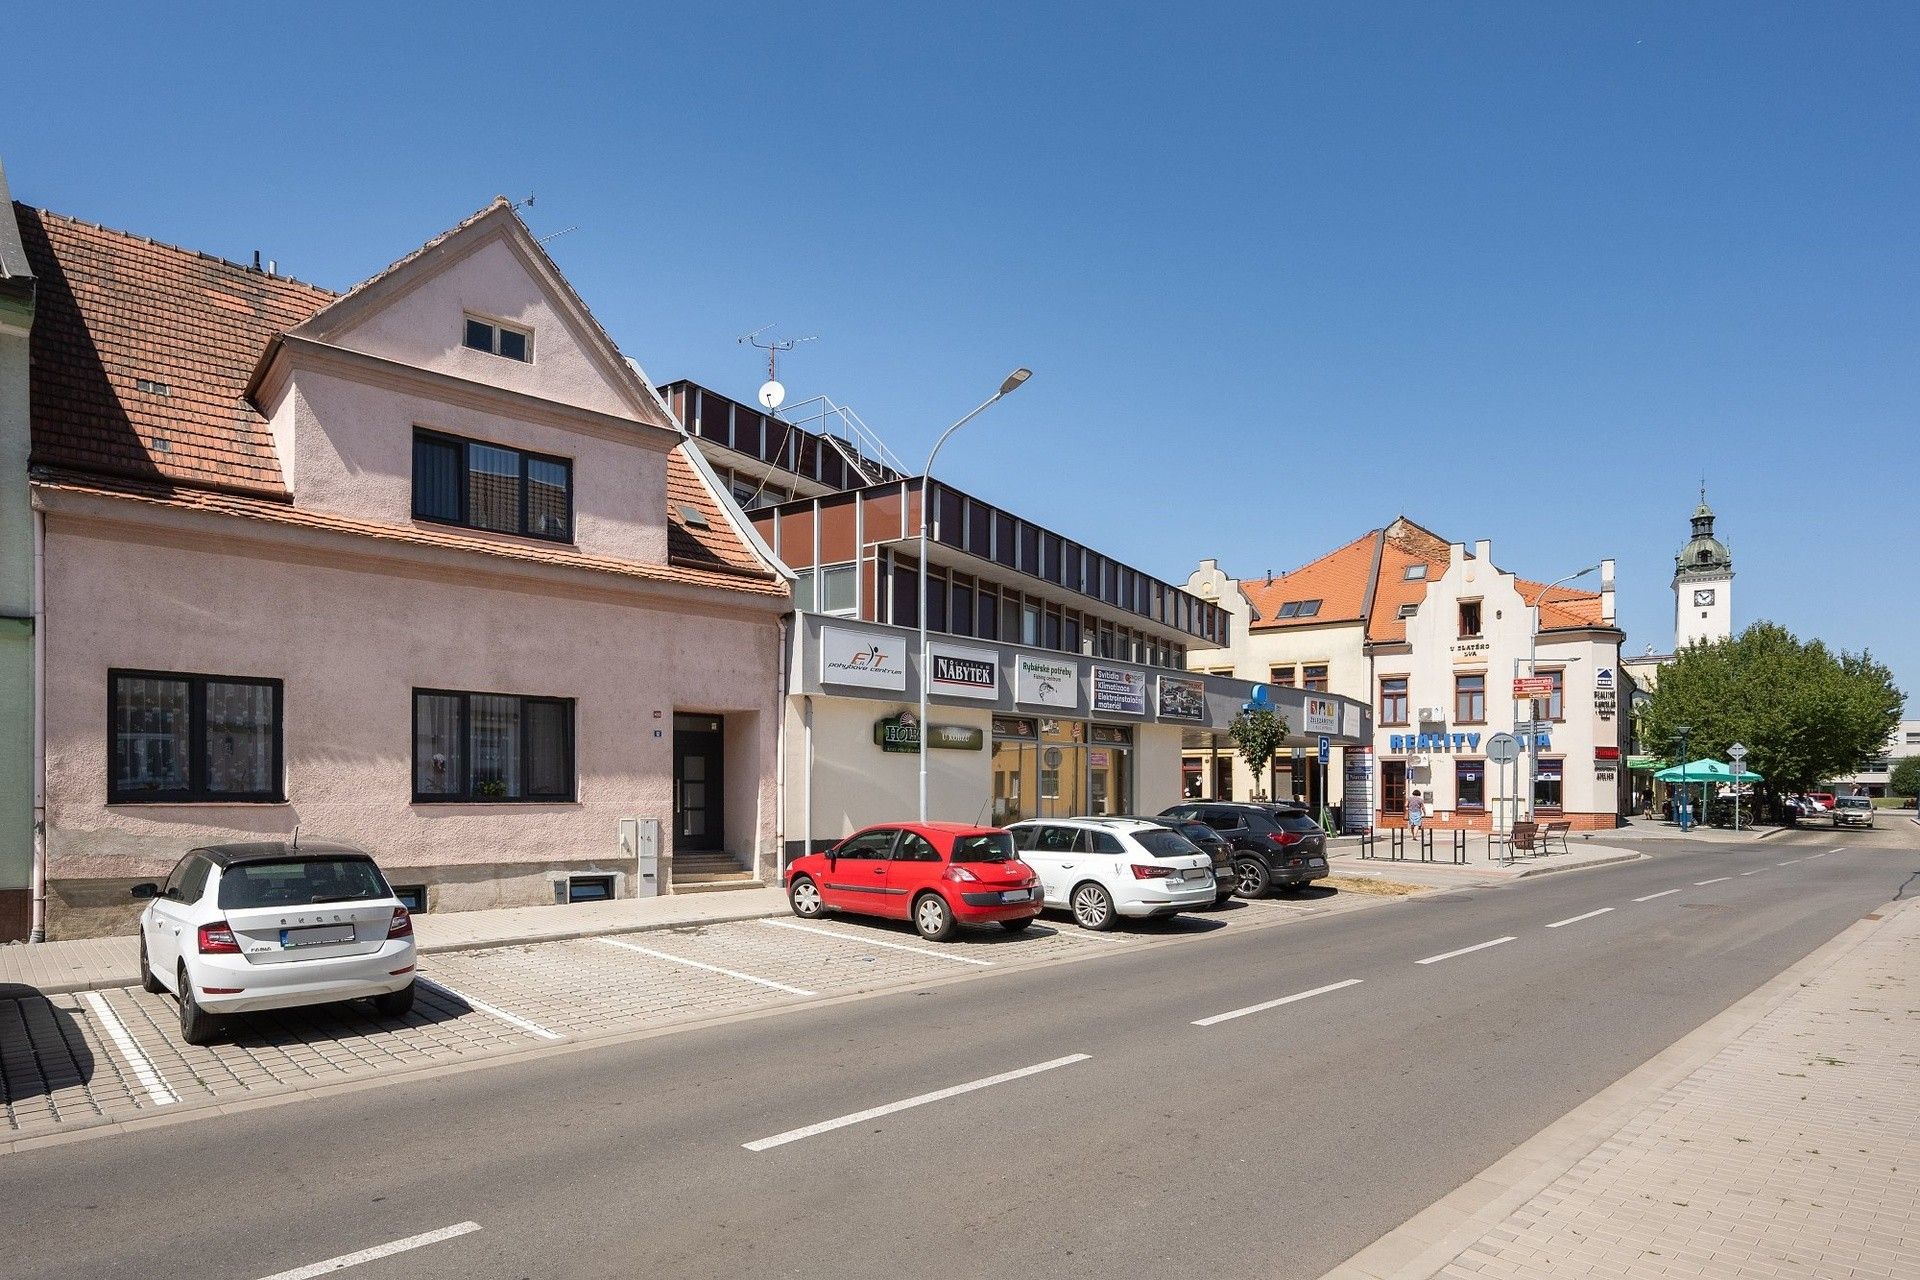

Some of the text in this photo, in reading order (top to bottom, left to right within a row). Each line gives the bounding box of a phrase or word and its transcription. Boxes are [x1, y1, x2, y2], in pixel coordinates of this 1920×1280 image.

[870, 667, 902, 675] centrum
[1050, 667, 1072, 679] potřeby
[1097, 681, 1130, 692] Klimatizace
[1390, 732, 1480, 749] REALITY
[1321, 739, 1328, 756] P
